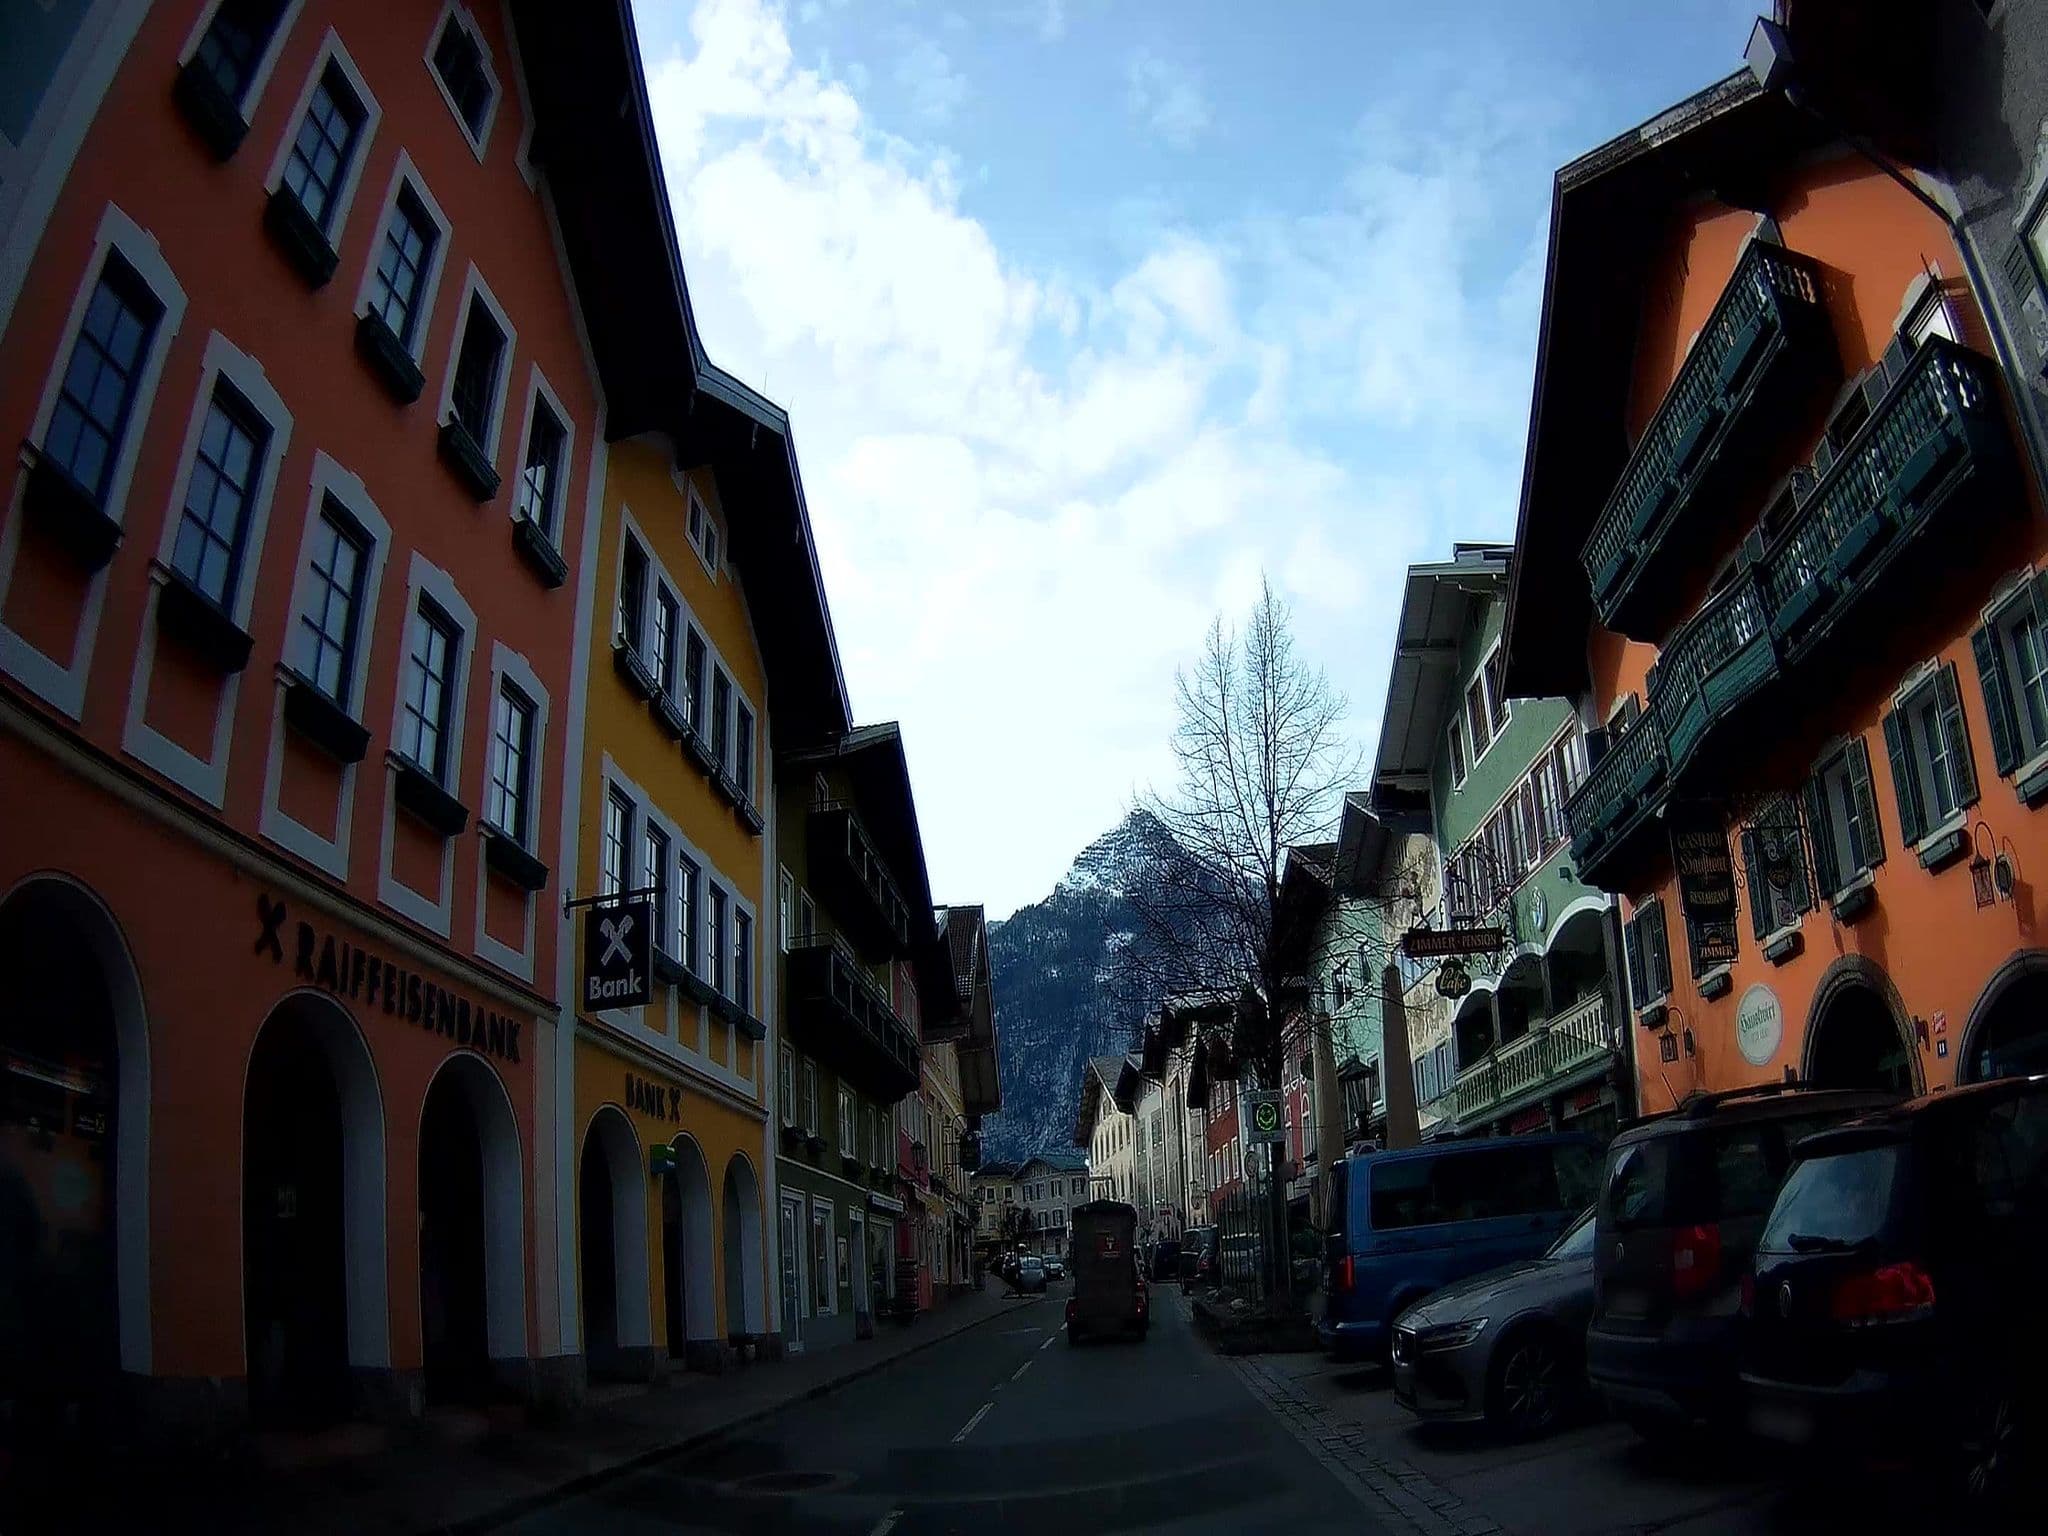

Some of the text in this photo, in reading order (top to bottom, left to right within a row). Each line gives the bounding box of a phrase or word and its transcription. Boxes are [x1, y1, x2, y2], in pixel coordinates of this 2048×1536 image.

[1410, 932, 1498, 952] ZIMMER PENSION
[1699, 944, 1734, 960] ZIMMER
[296, 921, 521, 1064] RAIFFEISENBANK
[589, 968, 642, 1001] Bank
[626, 1072, 666, 1121] BANK
